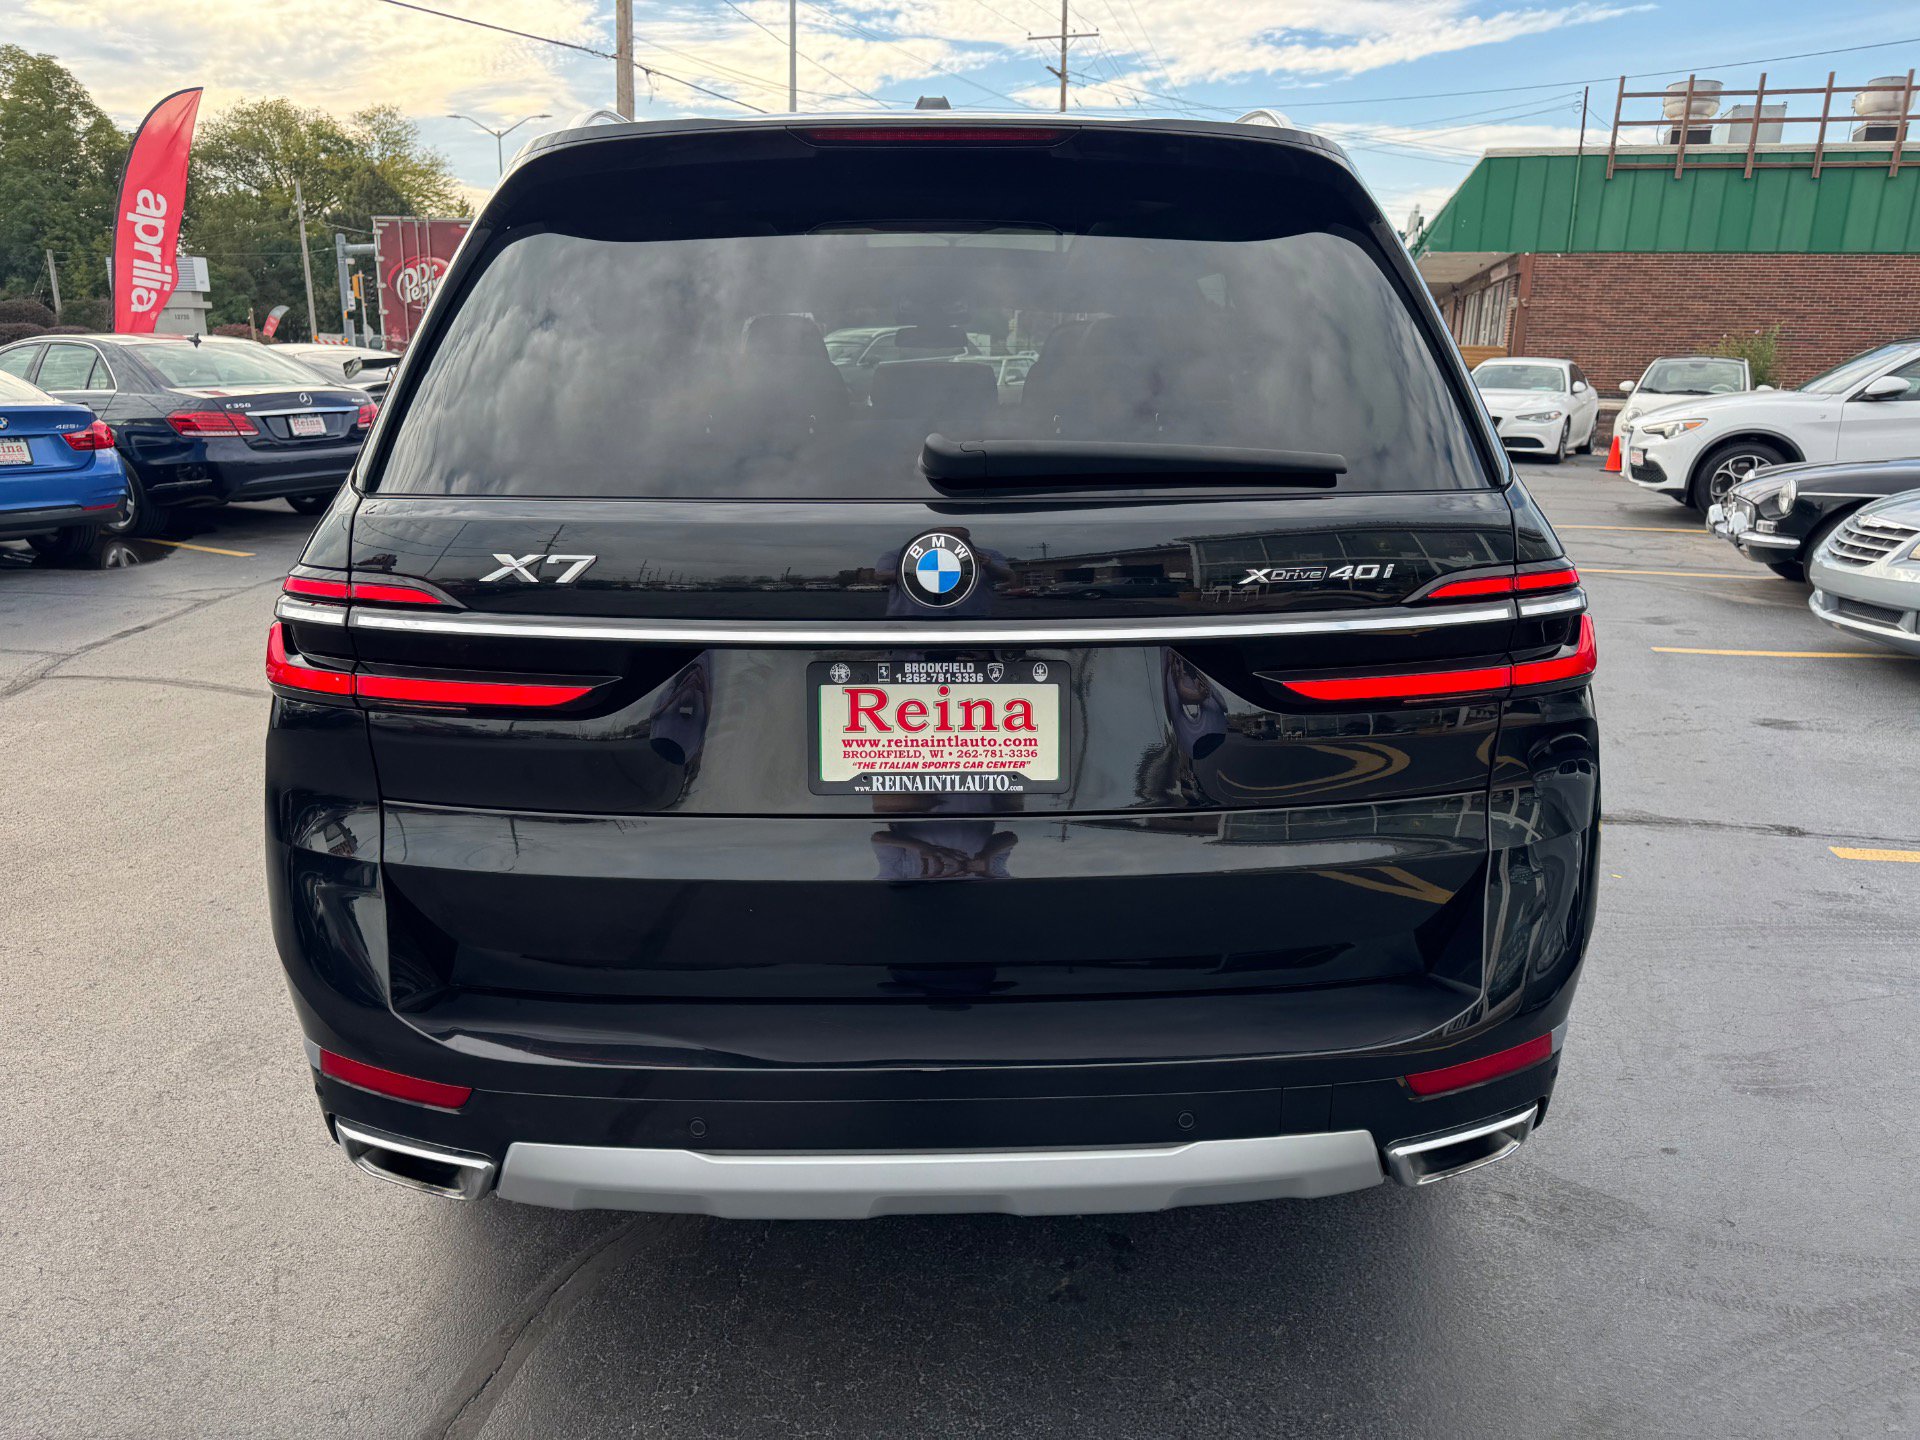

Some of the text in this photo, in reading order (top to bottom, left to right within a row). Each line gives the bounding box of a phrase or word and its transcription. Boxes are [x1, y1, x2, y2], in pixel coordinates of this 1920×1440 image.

[126, 188, 172, 313] aprilia
[293, 417, 321, 427] Reina
[0, 443, 24, 453] ina
[909, 536, 968, 560] BMW
[478, 553, 597, 583] X7
[1329, 563, 1395, 581] 40i
[904, 663, 975, 673] BROOKFIELD
[896, 673, 984, 683] 1-262-781-3336
[842, 684, 1038, 733] Reina
[841, 735, 1039, 748] www.reinaintlauto.com
[842, 749, 1038, 760] BROOKFIELD, WI 262-781-3336
[852, 761, 1031, 770] "THE ITALIAN SPORTS CAR CENTER"
